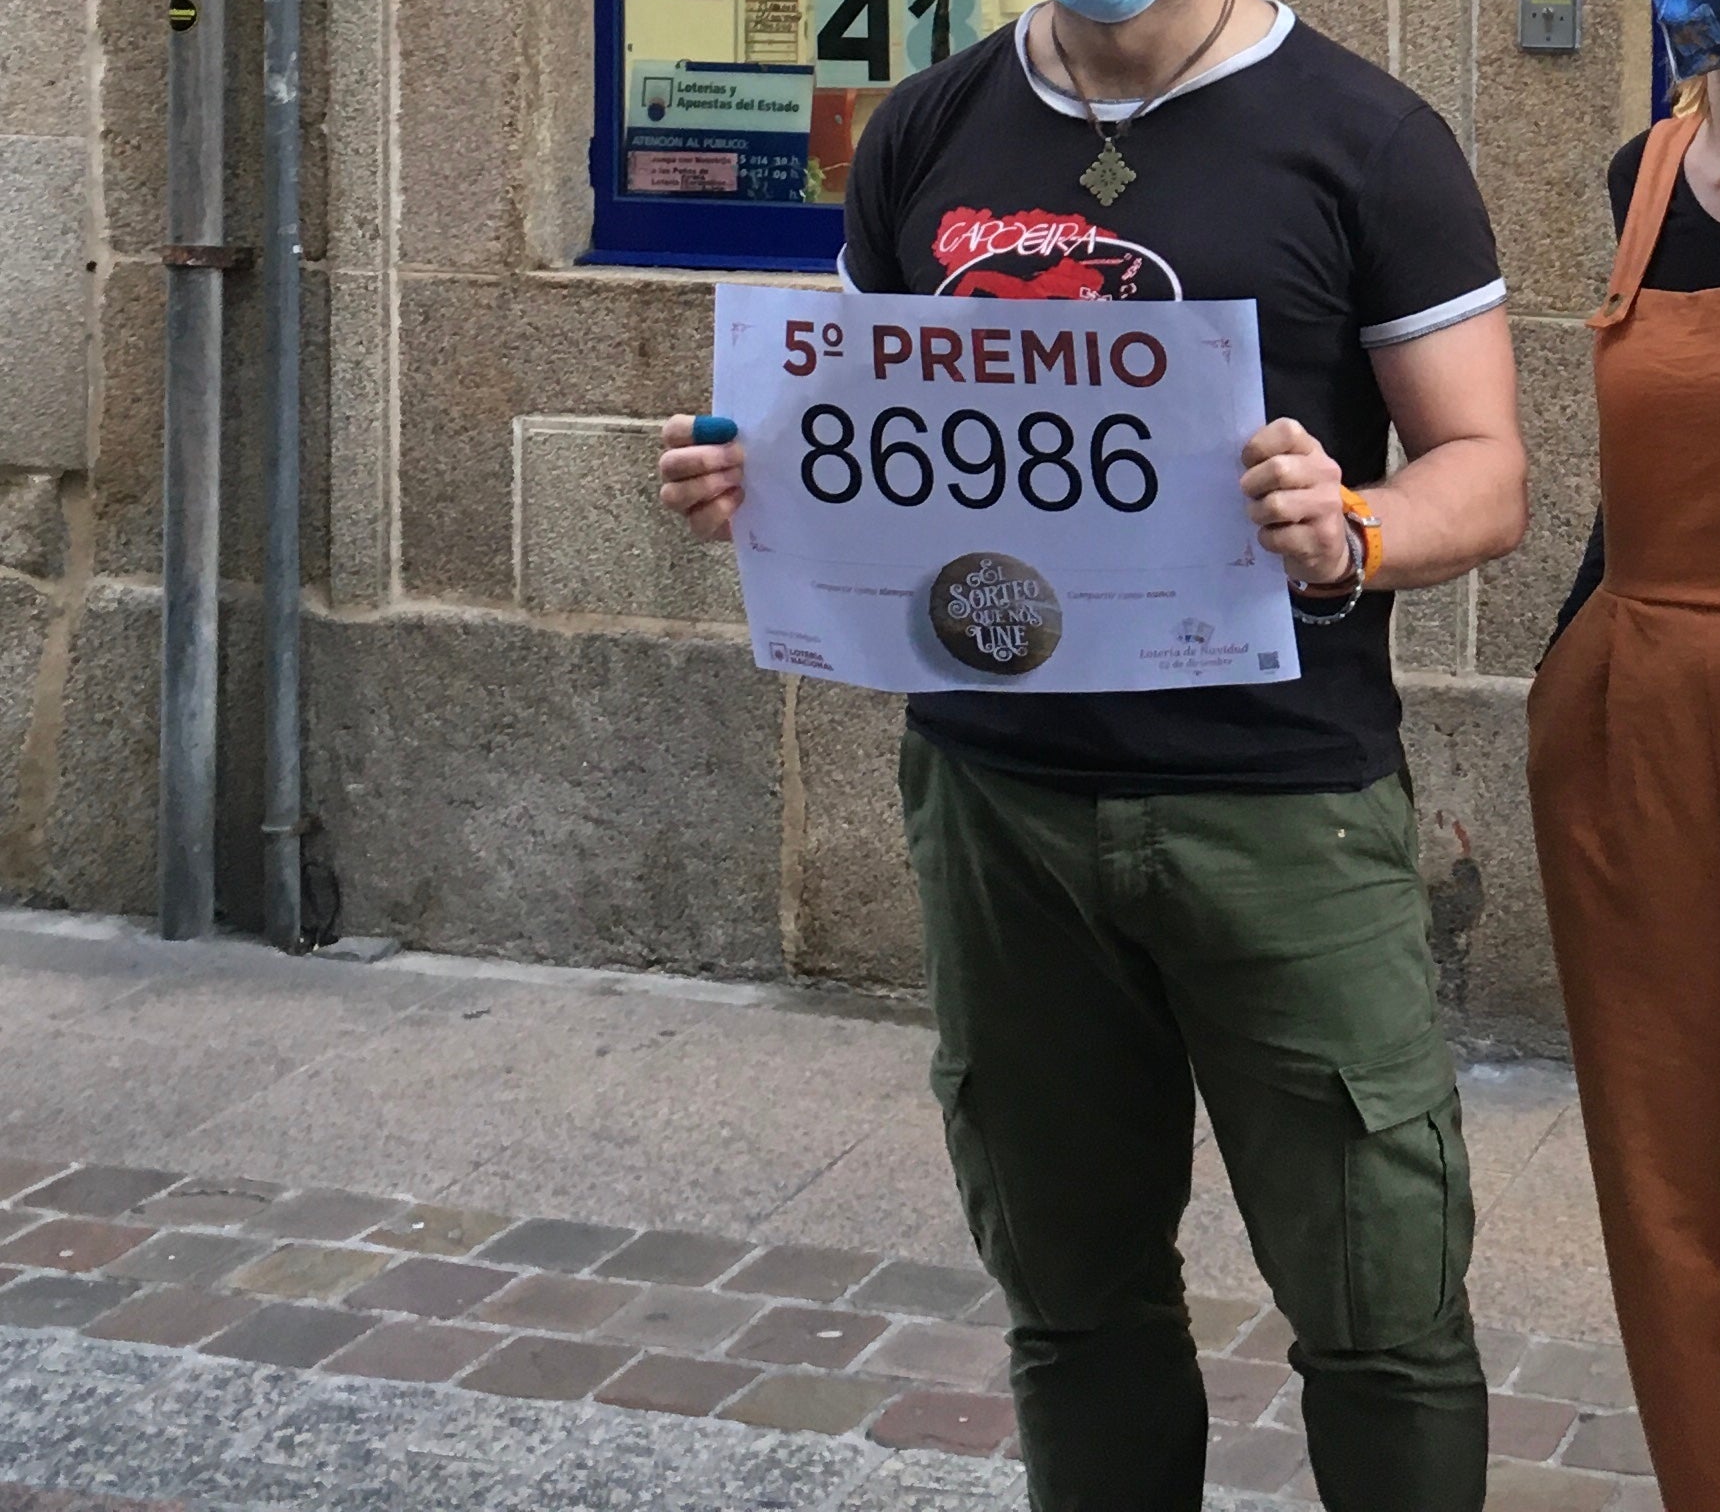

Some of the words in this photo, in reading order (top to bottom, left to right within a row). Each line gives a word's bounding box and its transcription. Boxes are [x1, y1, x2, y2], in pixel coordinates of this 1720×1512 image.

[677, 81, 727, 93] Loterías
[729, 86, 737, 98] y
[677, 97, 733, 111] Apuestas
[735, 99, 755, 111] del
[757, 100, 800, 113] Estado
[686, 137, 699, 148] AL
[939, 220, 1098, 256] CAPOEIRA
[783, 320, 845, 377] 5º
[872, 324, 1167, 388] PREMIO
[799, 403, 1160, 513] 86986
[947, 579, 1040, 619] SORTEO
[972, 609, 1006, 626] QUE
[965, 624, 1029, 662] UNE
[1183, 645, 1196, 656] de
